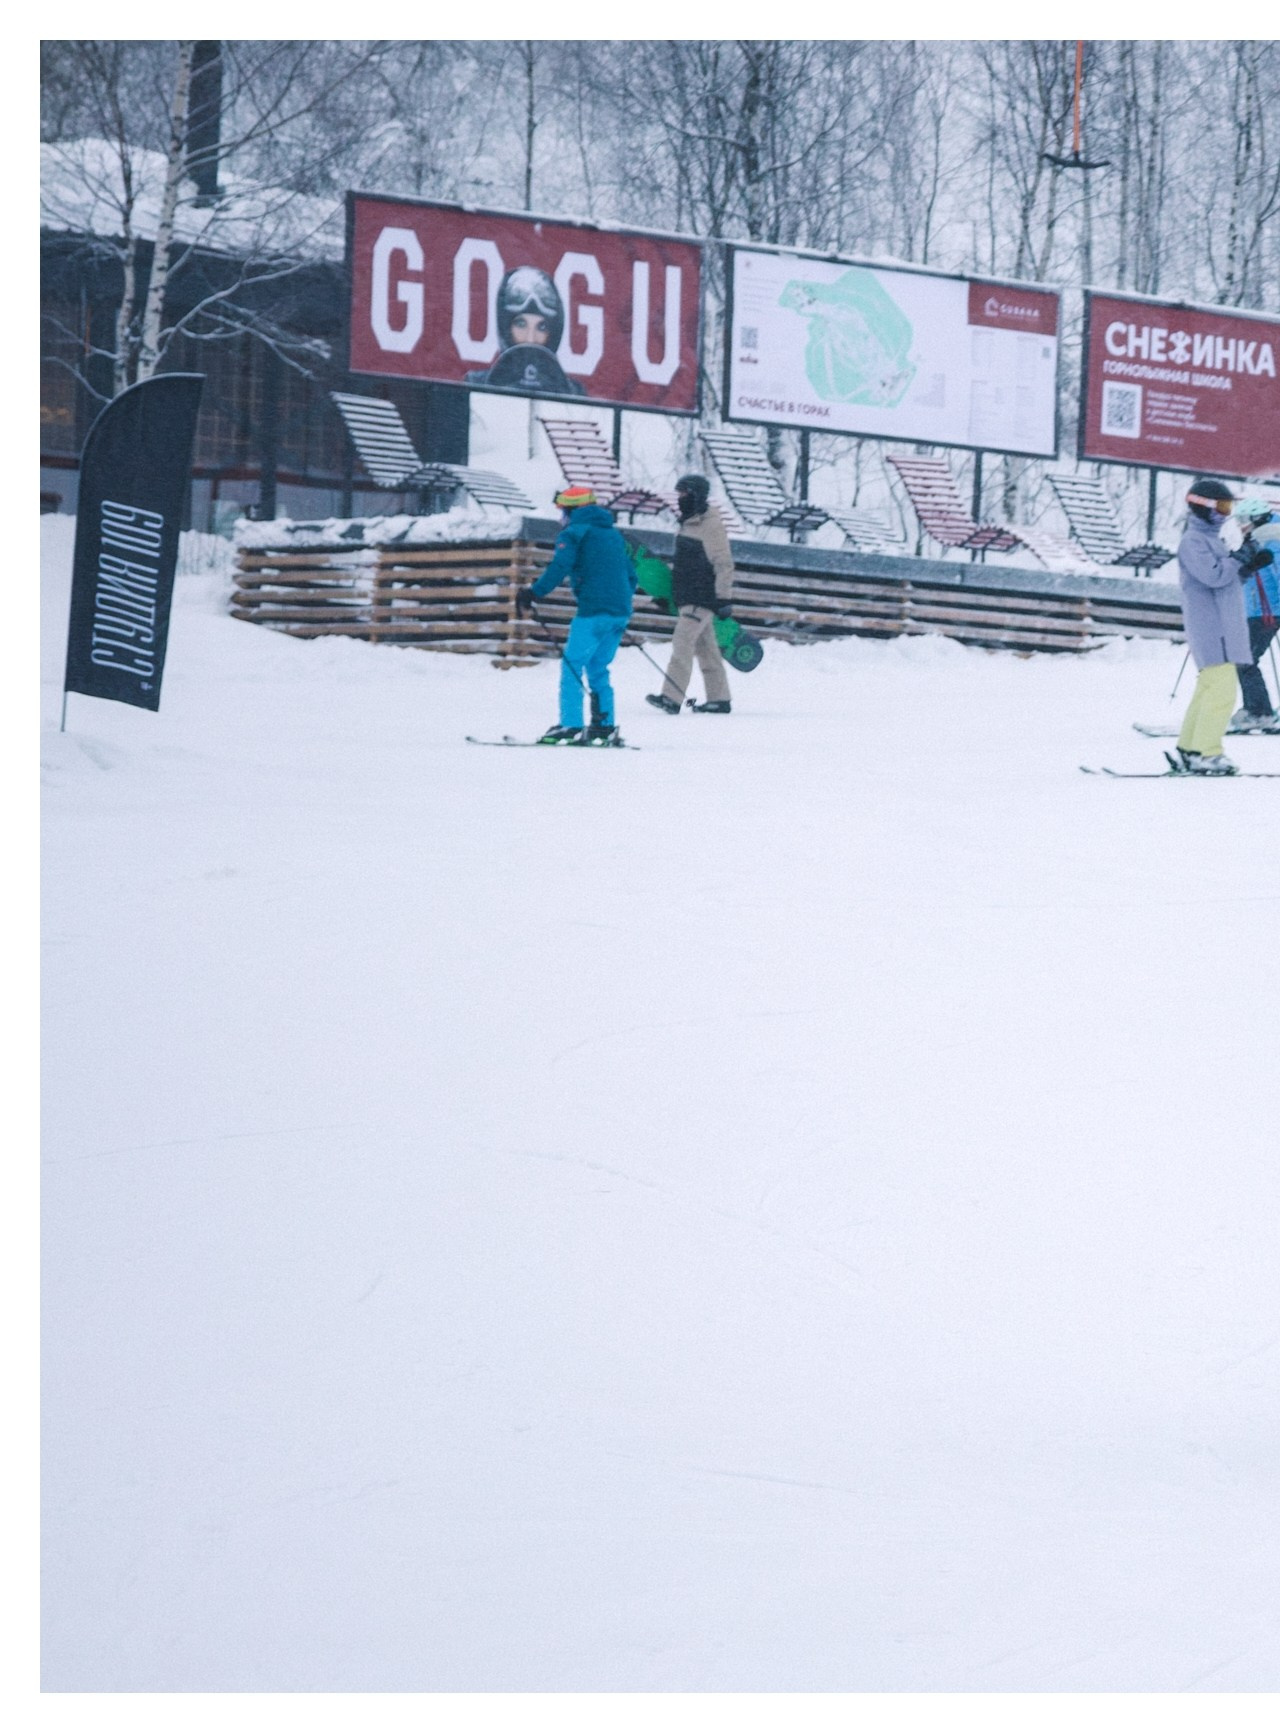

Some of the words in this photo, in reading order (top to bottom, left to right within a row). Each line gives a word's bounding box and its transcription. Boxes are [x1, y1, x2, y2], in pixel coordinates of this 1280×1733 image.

[1103, 360, 1189, 384] ГОРНОЛЫЖНАЯ
[1191, 373, 1232, 391] ШКОЛА
[1105, 321, 1276, 378] СНЕЖИНКА
[738, 395, 785, 412] СЧАСТЬЕ
[797, 403, 831, 416] ГОРАХ
[99, 500, 165, 558] 109
[90, 553, 159, 677] СТУДИЯ
